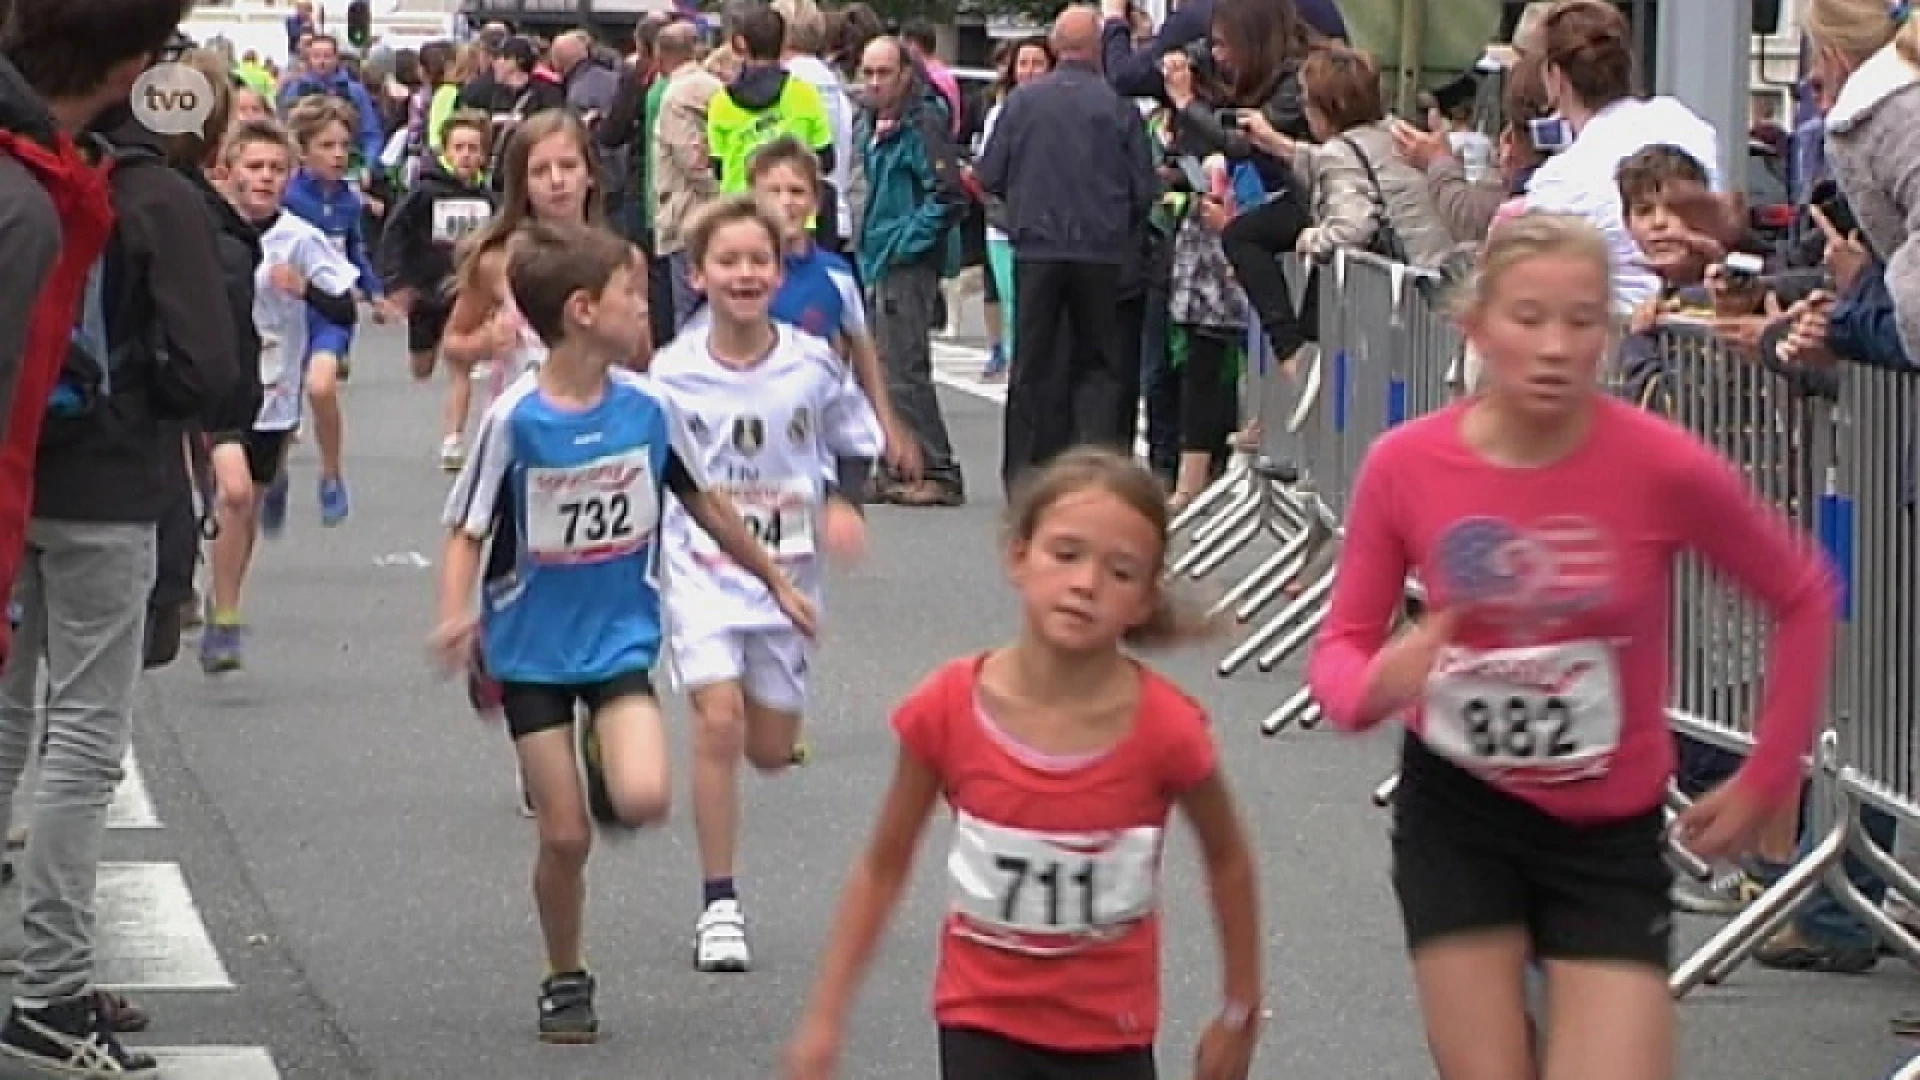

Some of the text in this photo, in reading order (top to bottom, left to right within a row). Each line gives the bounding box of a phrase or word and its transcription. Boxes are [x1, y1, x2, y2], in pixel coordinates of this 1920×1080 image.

[558, 492, 633, 546] 732
[1463, 696, 1578, 756] 882
[995, 854, 1094, 926] 711
